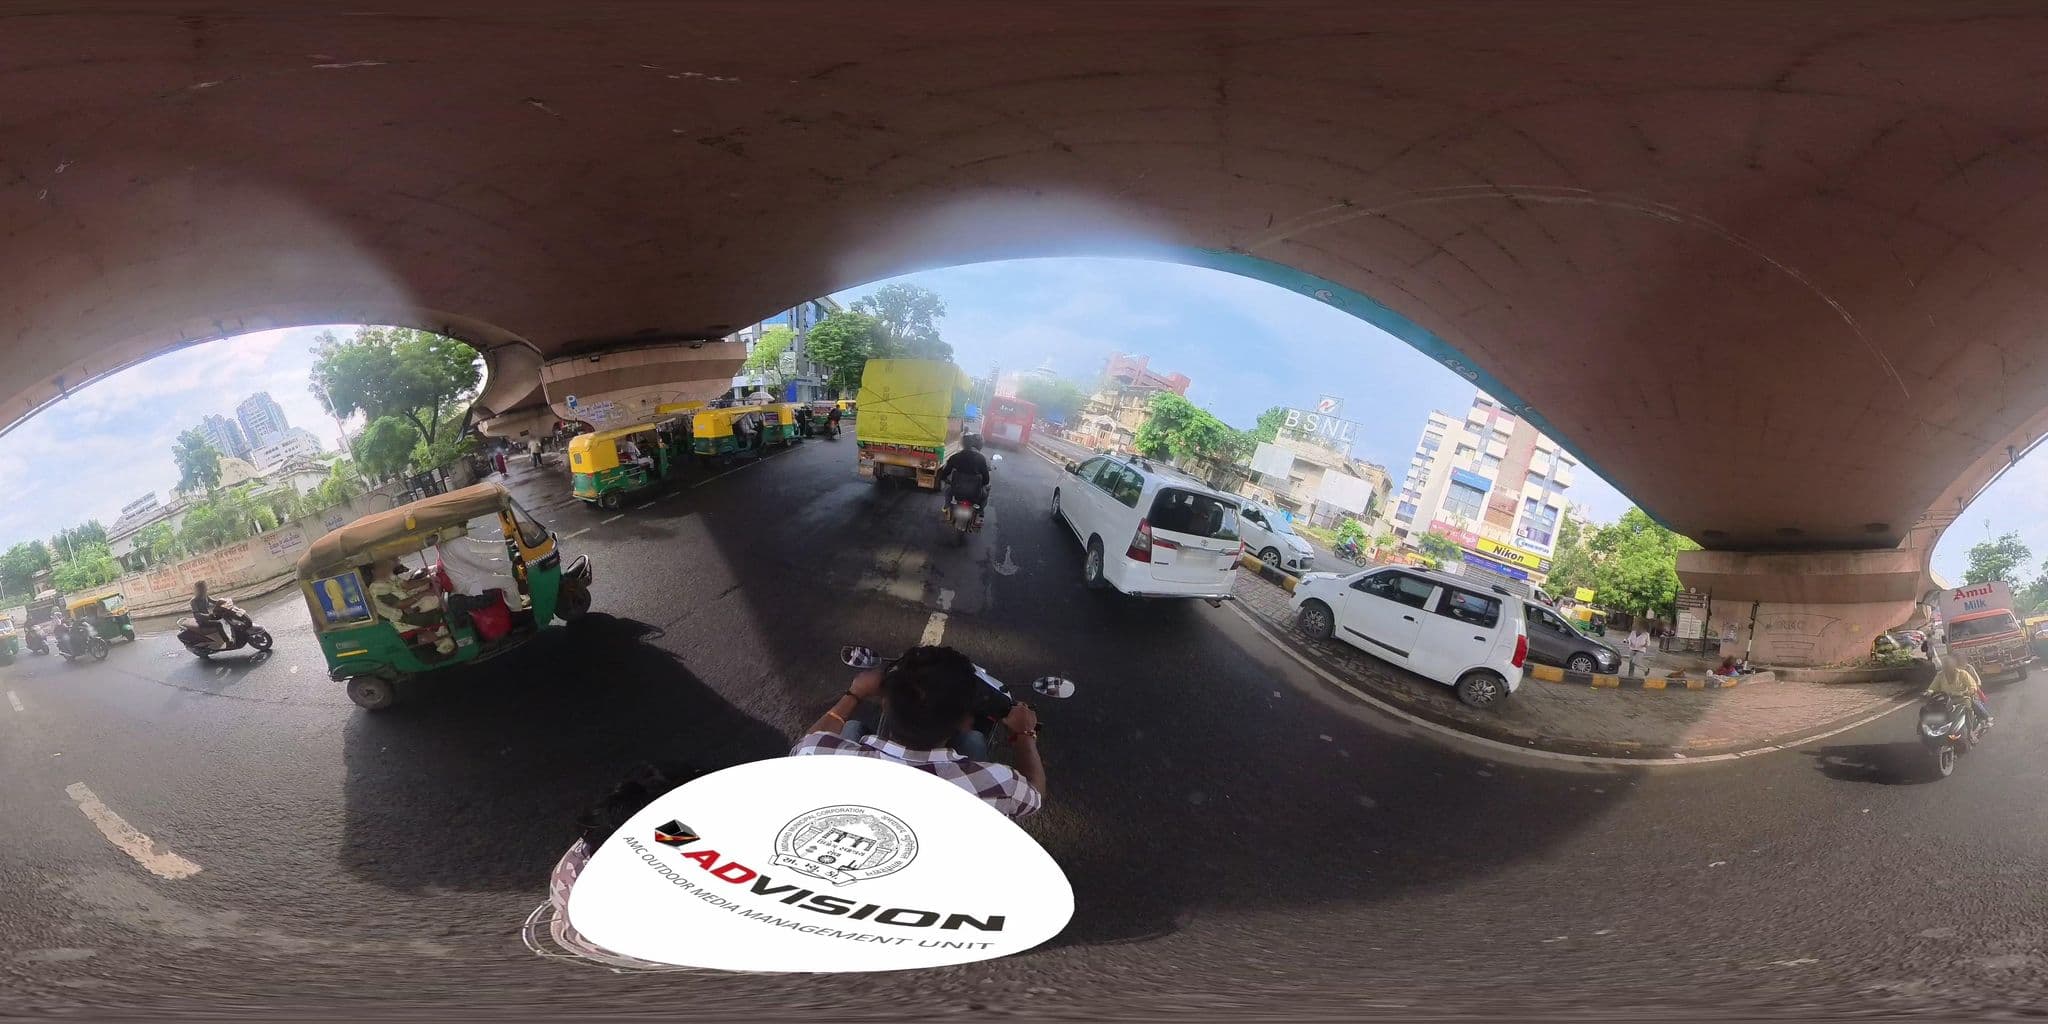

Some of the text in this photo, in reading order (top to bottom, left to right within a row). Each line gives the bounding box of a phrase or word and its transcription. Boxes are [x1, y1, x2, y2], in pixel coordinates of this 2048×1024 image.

[1284, 408, 1352, 442] BSNL
[1492, 545, 1525, 562] Nikon
[1953, 583, 1994, 601] Amul
[1963, 600, 1987, 611] Milk
